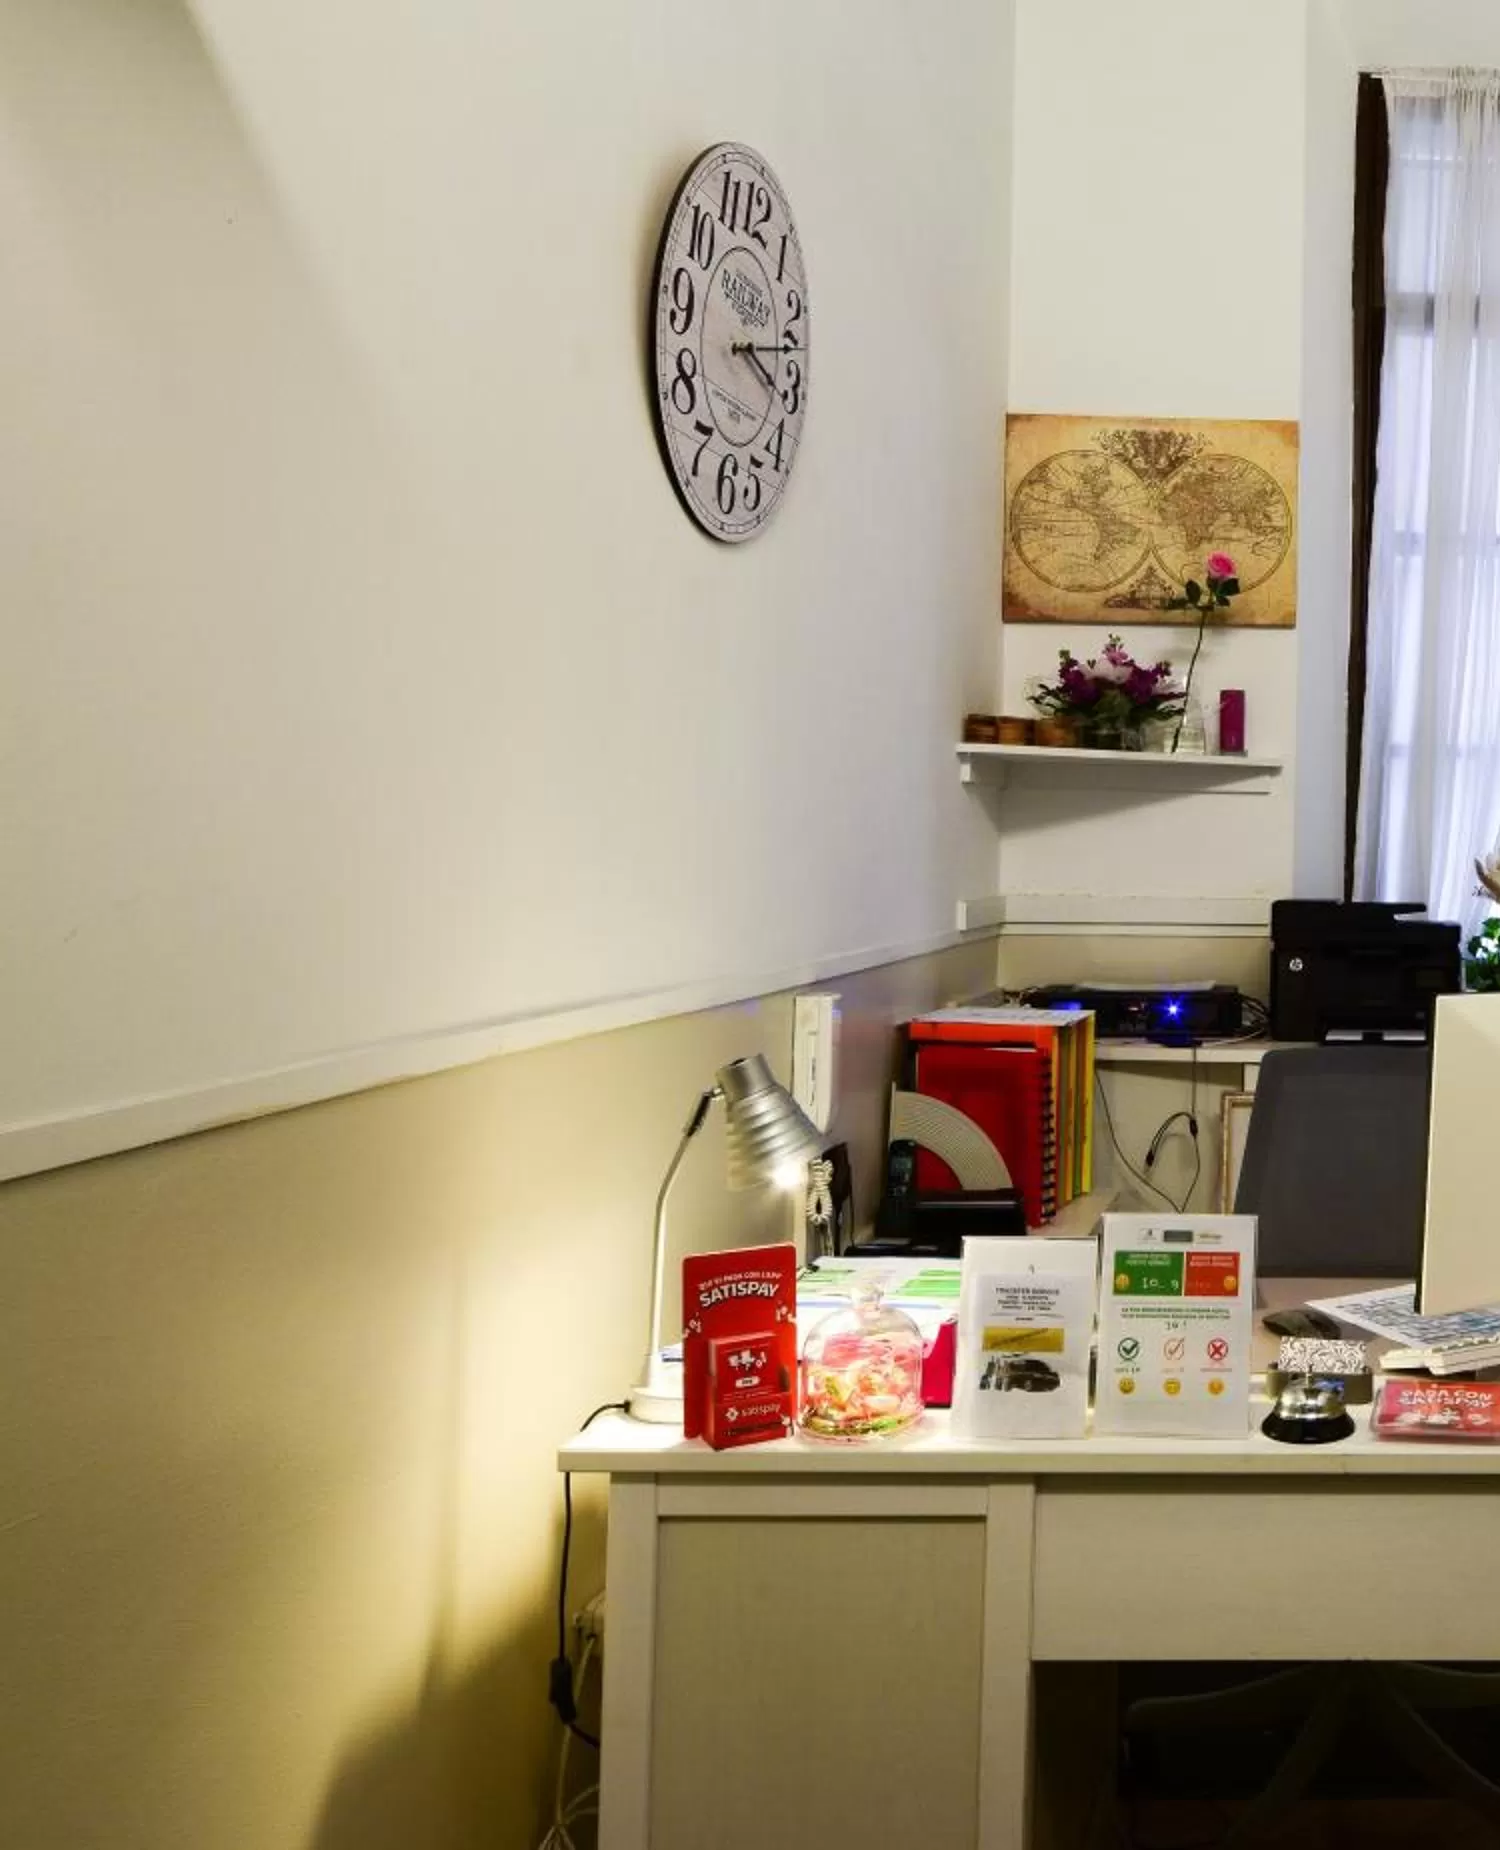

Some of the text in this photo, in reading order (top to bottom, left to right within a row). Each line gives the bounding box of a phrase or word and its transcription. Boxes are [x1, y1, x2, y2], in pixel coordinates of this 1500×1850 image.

[718, 171, 741, 234] 11
[744, 181, 772, 249] 12
[687, 203, 715, 271] 10
[776, 233, 788, 283] 1
[669, 267, 695, 335] 9
[783, 289, 801, 346] 2
[671, 347, 697, 414] 8
[781, 359, 800, 415] 3
[691, 419, 713, 477] 7
[764, 418, 785, 472] 4
[717, 453, 738, 515] 6
[743, 454, 763, 512] 5
[700, 1281, 779, 1308] SATISPAY
